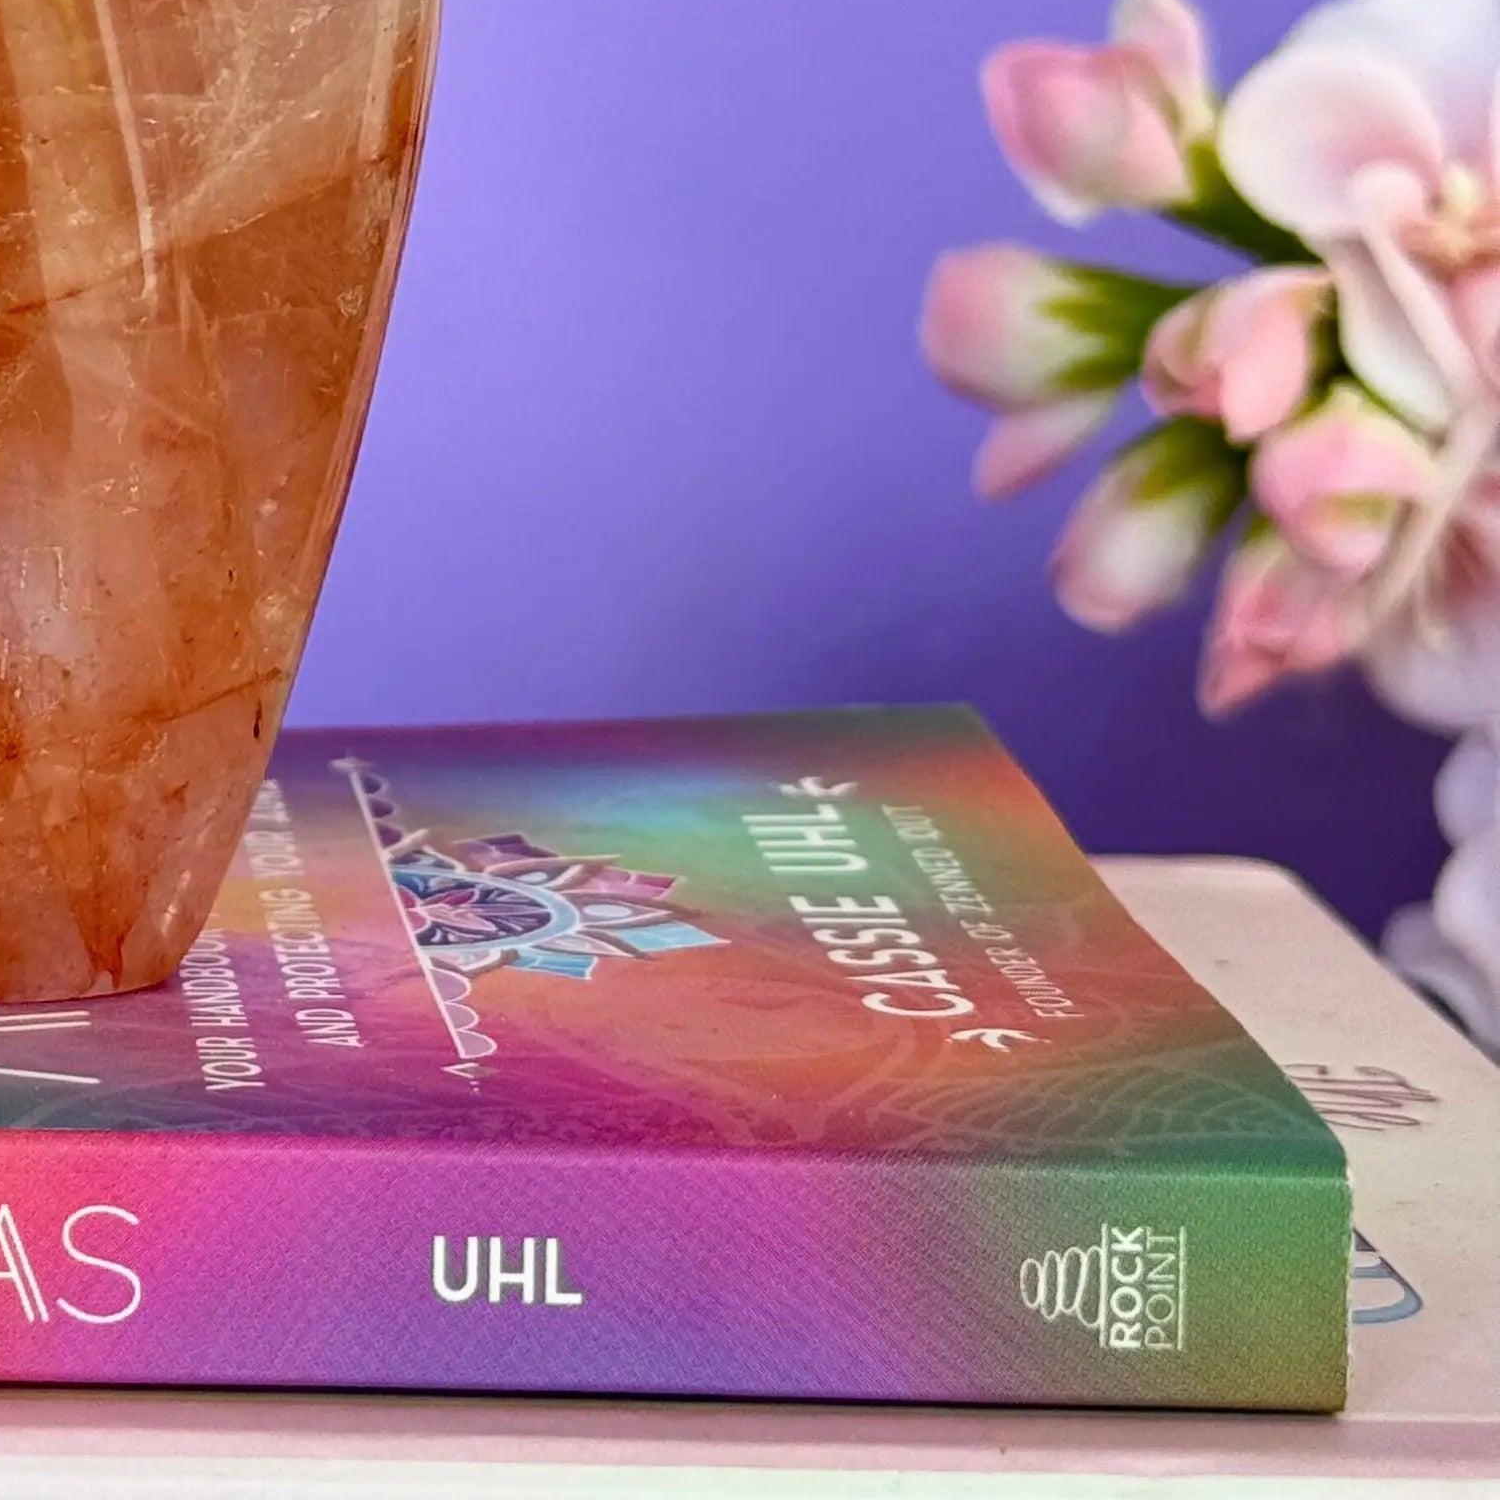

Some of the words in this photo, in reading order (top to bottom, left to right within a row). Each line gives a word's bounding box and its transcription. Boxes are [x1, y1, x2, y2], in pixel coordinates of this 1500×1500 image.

[244, 830, 306, 878] YOUR
[741, 803, 868, 874] UHL
[882, 803, 941, 843] OUT
[910, 846, 994, 917] ZENNED
[258, 888, 347, 1000] PROTECTING
[788, 894, 974, 1019] CASSIE
[960, 918, 1015, 942] OF
[986, 946, 1085, 1020] FOUNDER
[294, 1007, 364, 1048] AND
[195, 1036, 266, 1092] YOUR
[430, 1234, 584, 1307] UHL
[1108, 1225, 1145, 1350] ROCK
[1144, 1232, 1180, 1352] POINT
